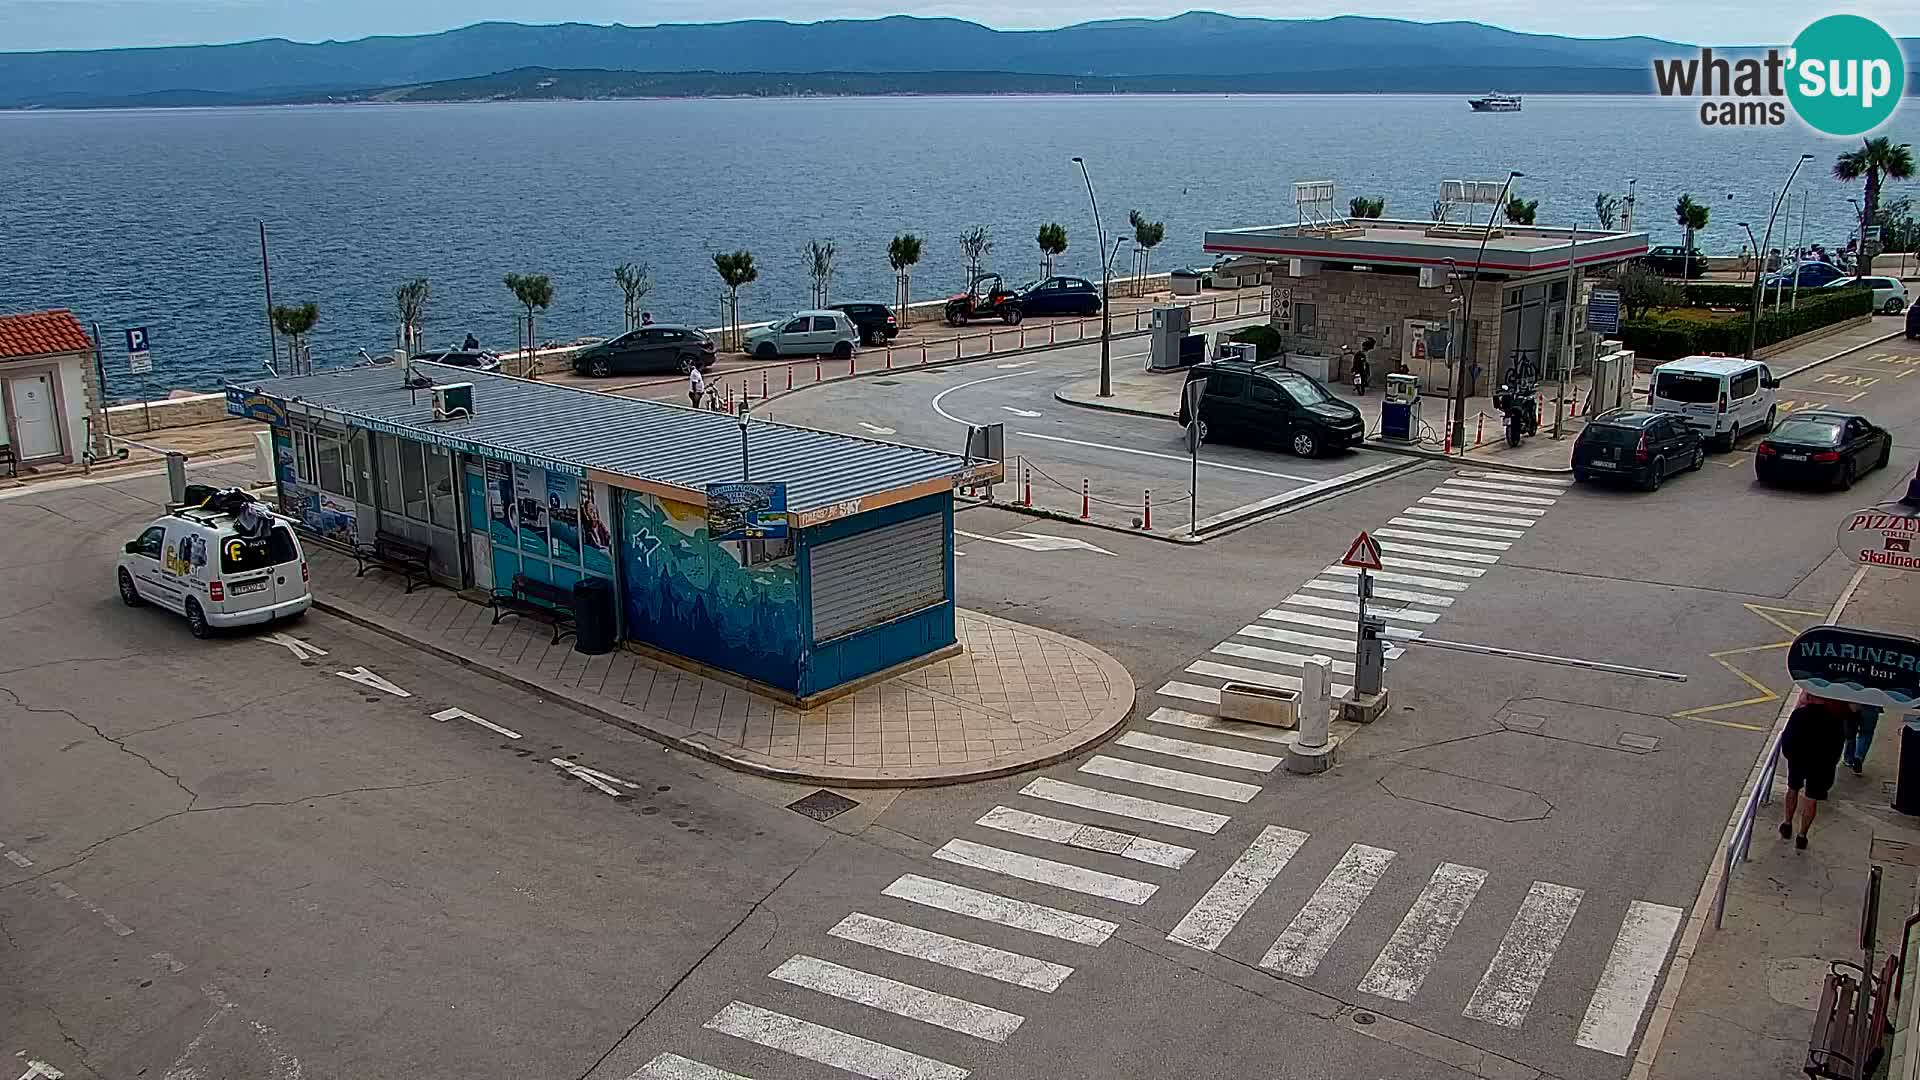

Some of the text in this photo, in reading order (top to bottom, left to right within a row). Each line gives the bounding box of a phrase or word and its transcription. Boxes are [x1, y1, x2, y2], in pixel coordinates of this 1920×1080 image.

[131, 331, 143, 349] P
[1814, 373, 1881, 388] TAXI
[1776, 400, 1829, 412] AXI
[437, 436, 468, 451] POSTAJA
[479, 445, 494, 457] BUS
[494, 448, 527, 465] STATION
[528, 456, 555, 471] TICKET
[556, 462, 583, 477] OFFICE
[838, 499, 862, 516] SKY
[1848, 514, 1920, 533] PIZZE
[1881, 530, 1916, 541] GRILL
[1828, 662, 1896, 680] caffe bar
